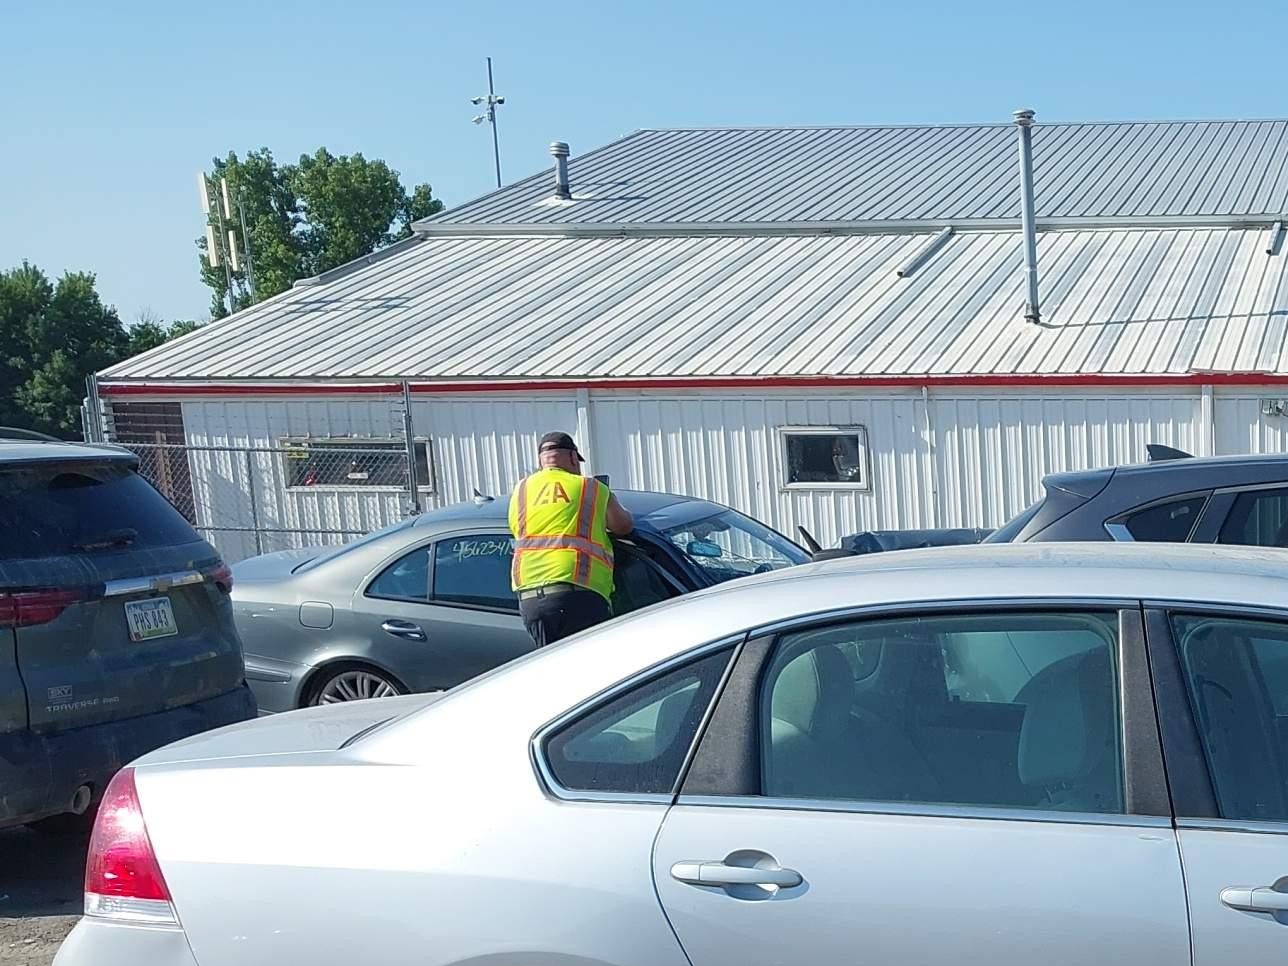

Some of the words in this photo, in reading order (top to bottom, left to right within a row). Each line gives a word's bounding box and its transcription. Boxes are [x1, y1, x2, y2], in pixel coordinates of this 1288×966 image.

[133, 611, 152, 631] PHS
[151, 609, 169, 629] 843
[45, 698, 99, 713] TRAVERSE
